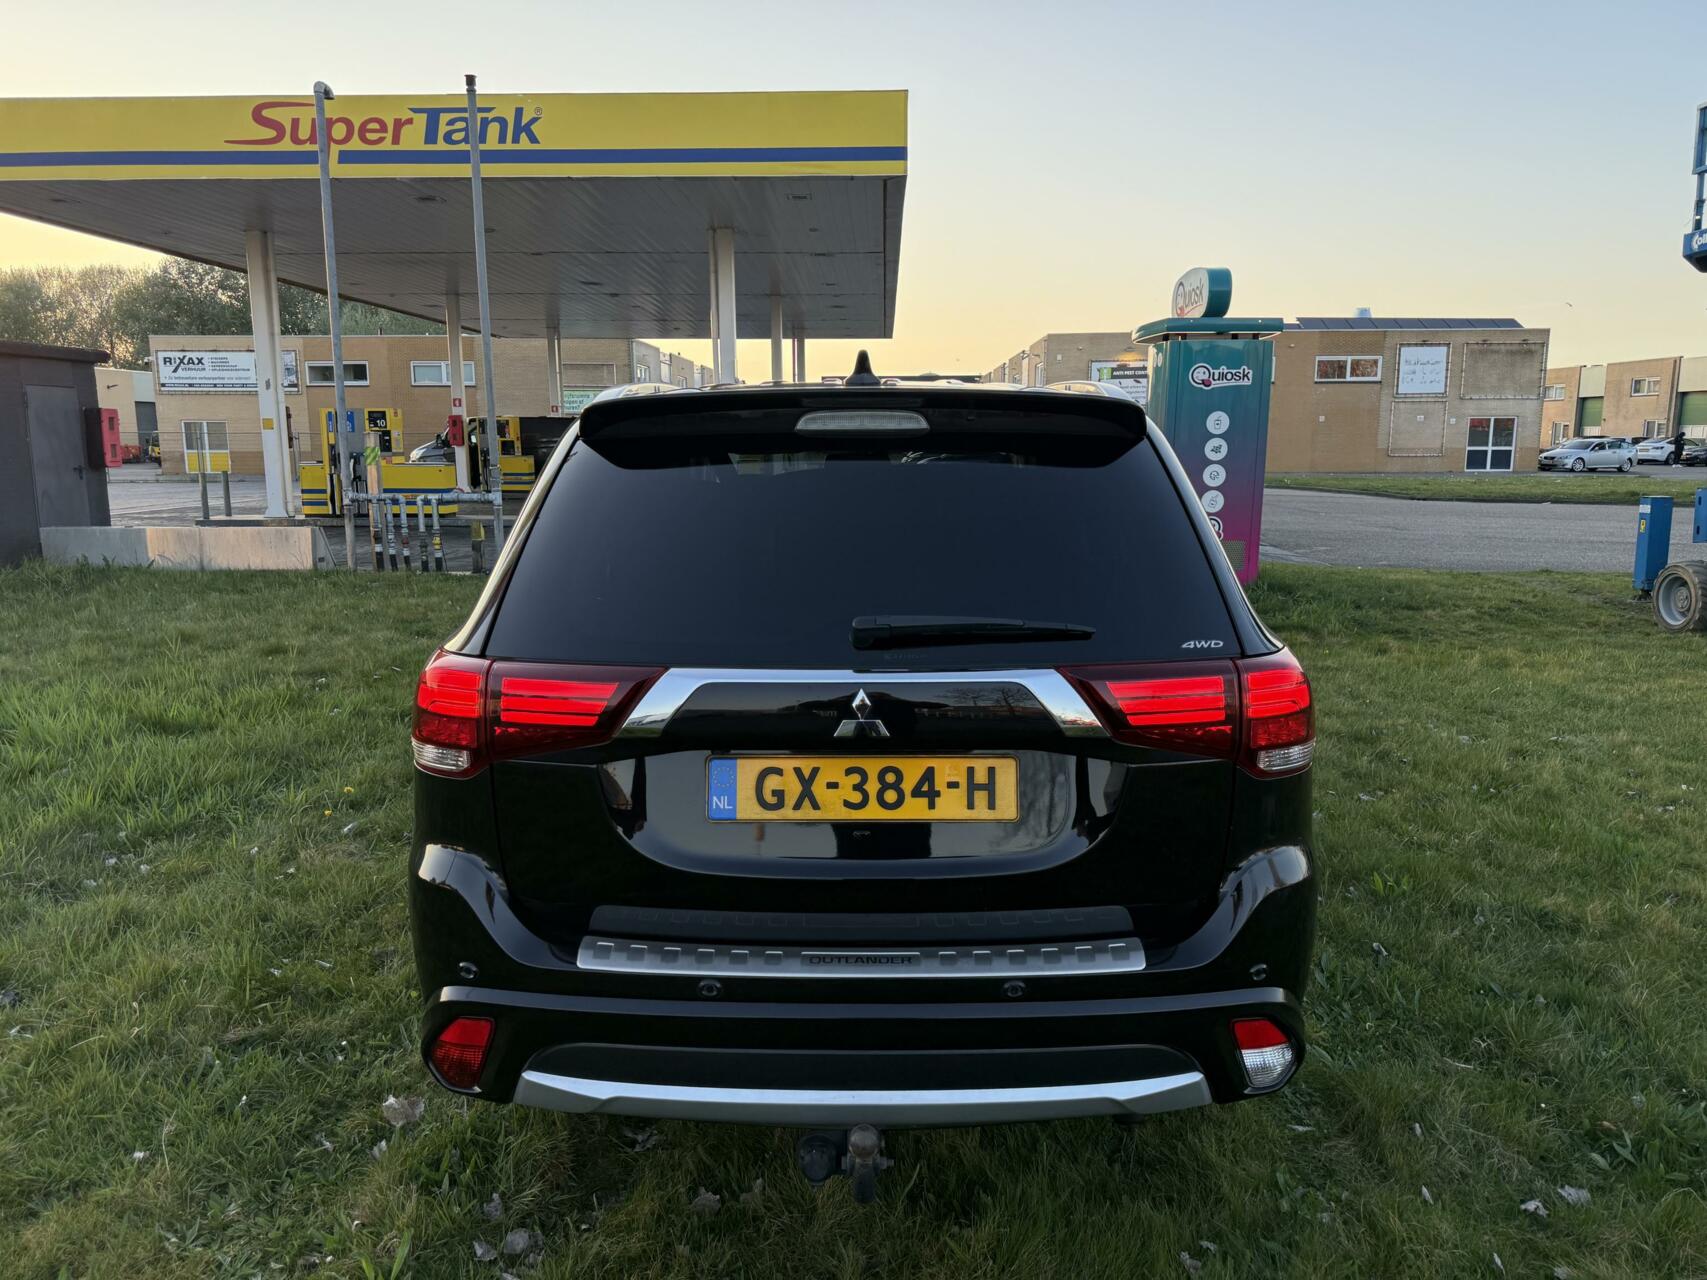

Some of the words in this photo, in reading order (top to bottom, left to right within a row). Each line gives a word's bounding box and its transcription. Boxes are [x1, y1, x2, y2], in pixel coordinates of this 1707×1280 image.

[1175, 279, 1204, 317] Quiosk
[1191, 365, 1251, 388] Quiosk
[376, 419, 386, 427] 10
[1181, 640, 1224, 648] 4WD
[712, 795, 733, 809] NL
[755, 766, 996, 811] GX-384-H
[809, 956, 913, 965] OUTLANDER
